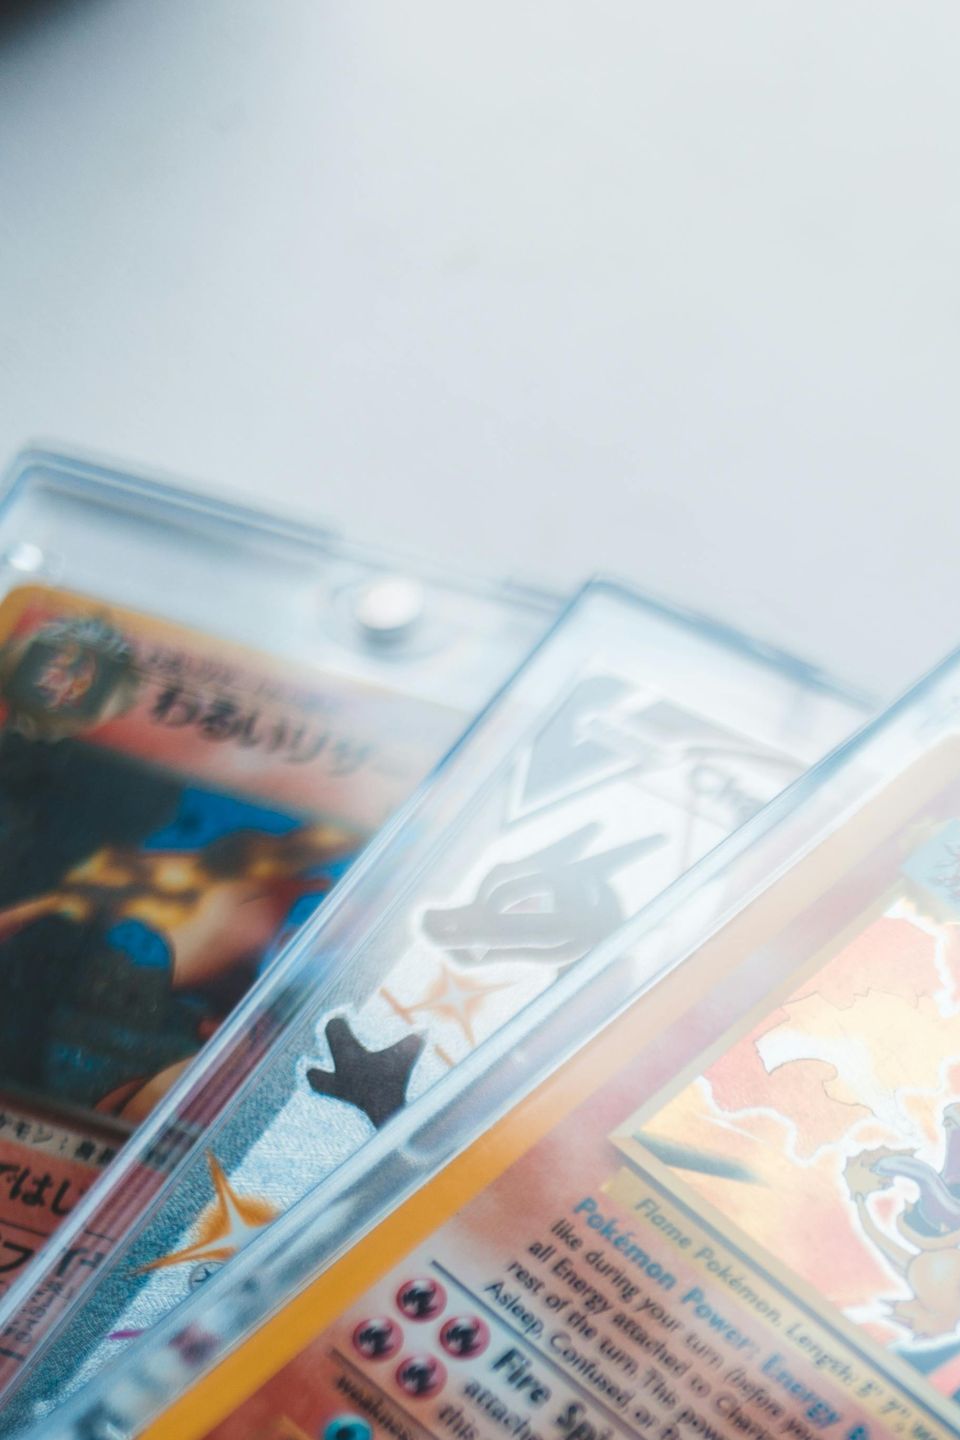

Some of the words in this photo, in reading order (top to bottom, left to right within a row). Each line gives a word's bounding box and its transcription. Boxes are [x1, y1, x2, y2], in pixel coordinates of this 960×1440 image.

[503, 1258, 548, 1296] rest
[541, 1288, 572, 1315] of
[565, 1308, 605, 1342] the
[637, 1367, 684, 1410] This
[525, 1238, 555, 1264] all
[546, 1260, 616, 1319] Energy
[611, 1309, 691, 1376] attached
[547, 1217, 590, 1253] like
[578, 1247, 644, 1302] during
[635, 1296, 684, 1339] your
[680, 1330, 727, 1370] turn
[571, 1197, 684, 1290] Pokémon
[680, 1287, 766, 1359] Power:
[754, 1352, 846, 1431] Energy
[634, 1198, 695, 1249] Flame
[691, 1244, 790, 1326] Pokémon.
[482, 1279, 551, 1338] Asleep,
[545, 1330, 640, 1411] Confused,
[632, 1406, 660, 1431] or
[491, 1348, 560, 1407] Fire
